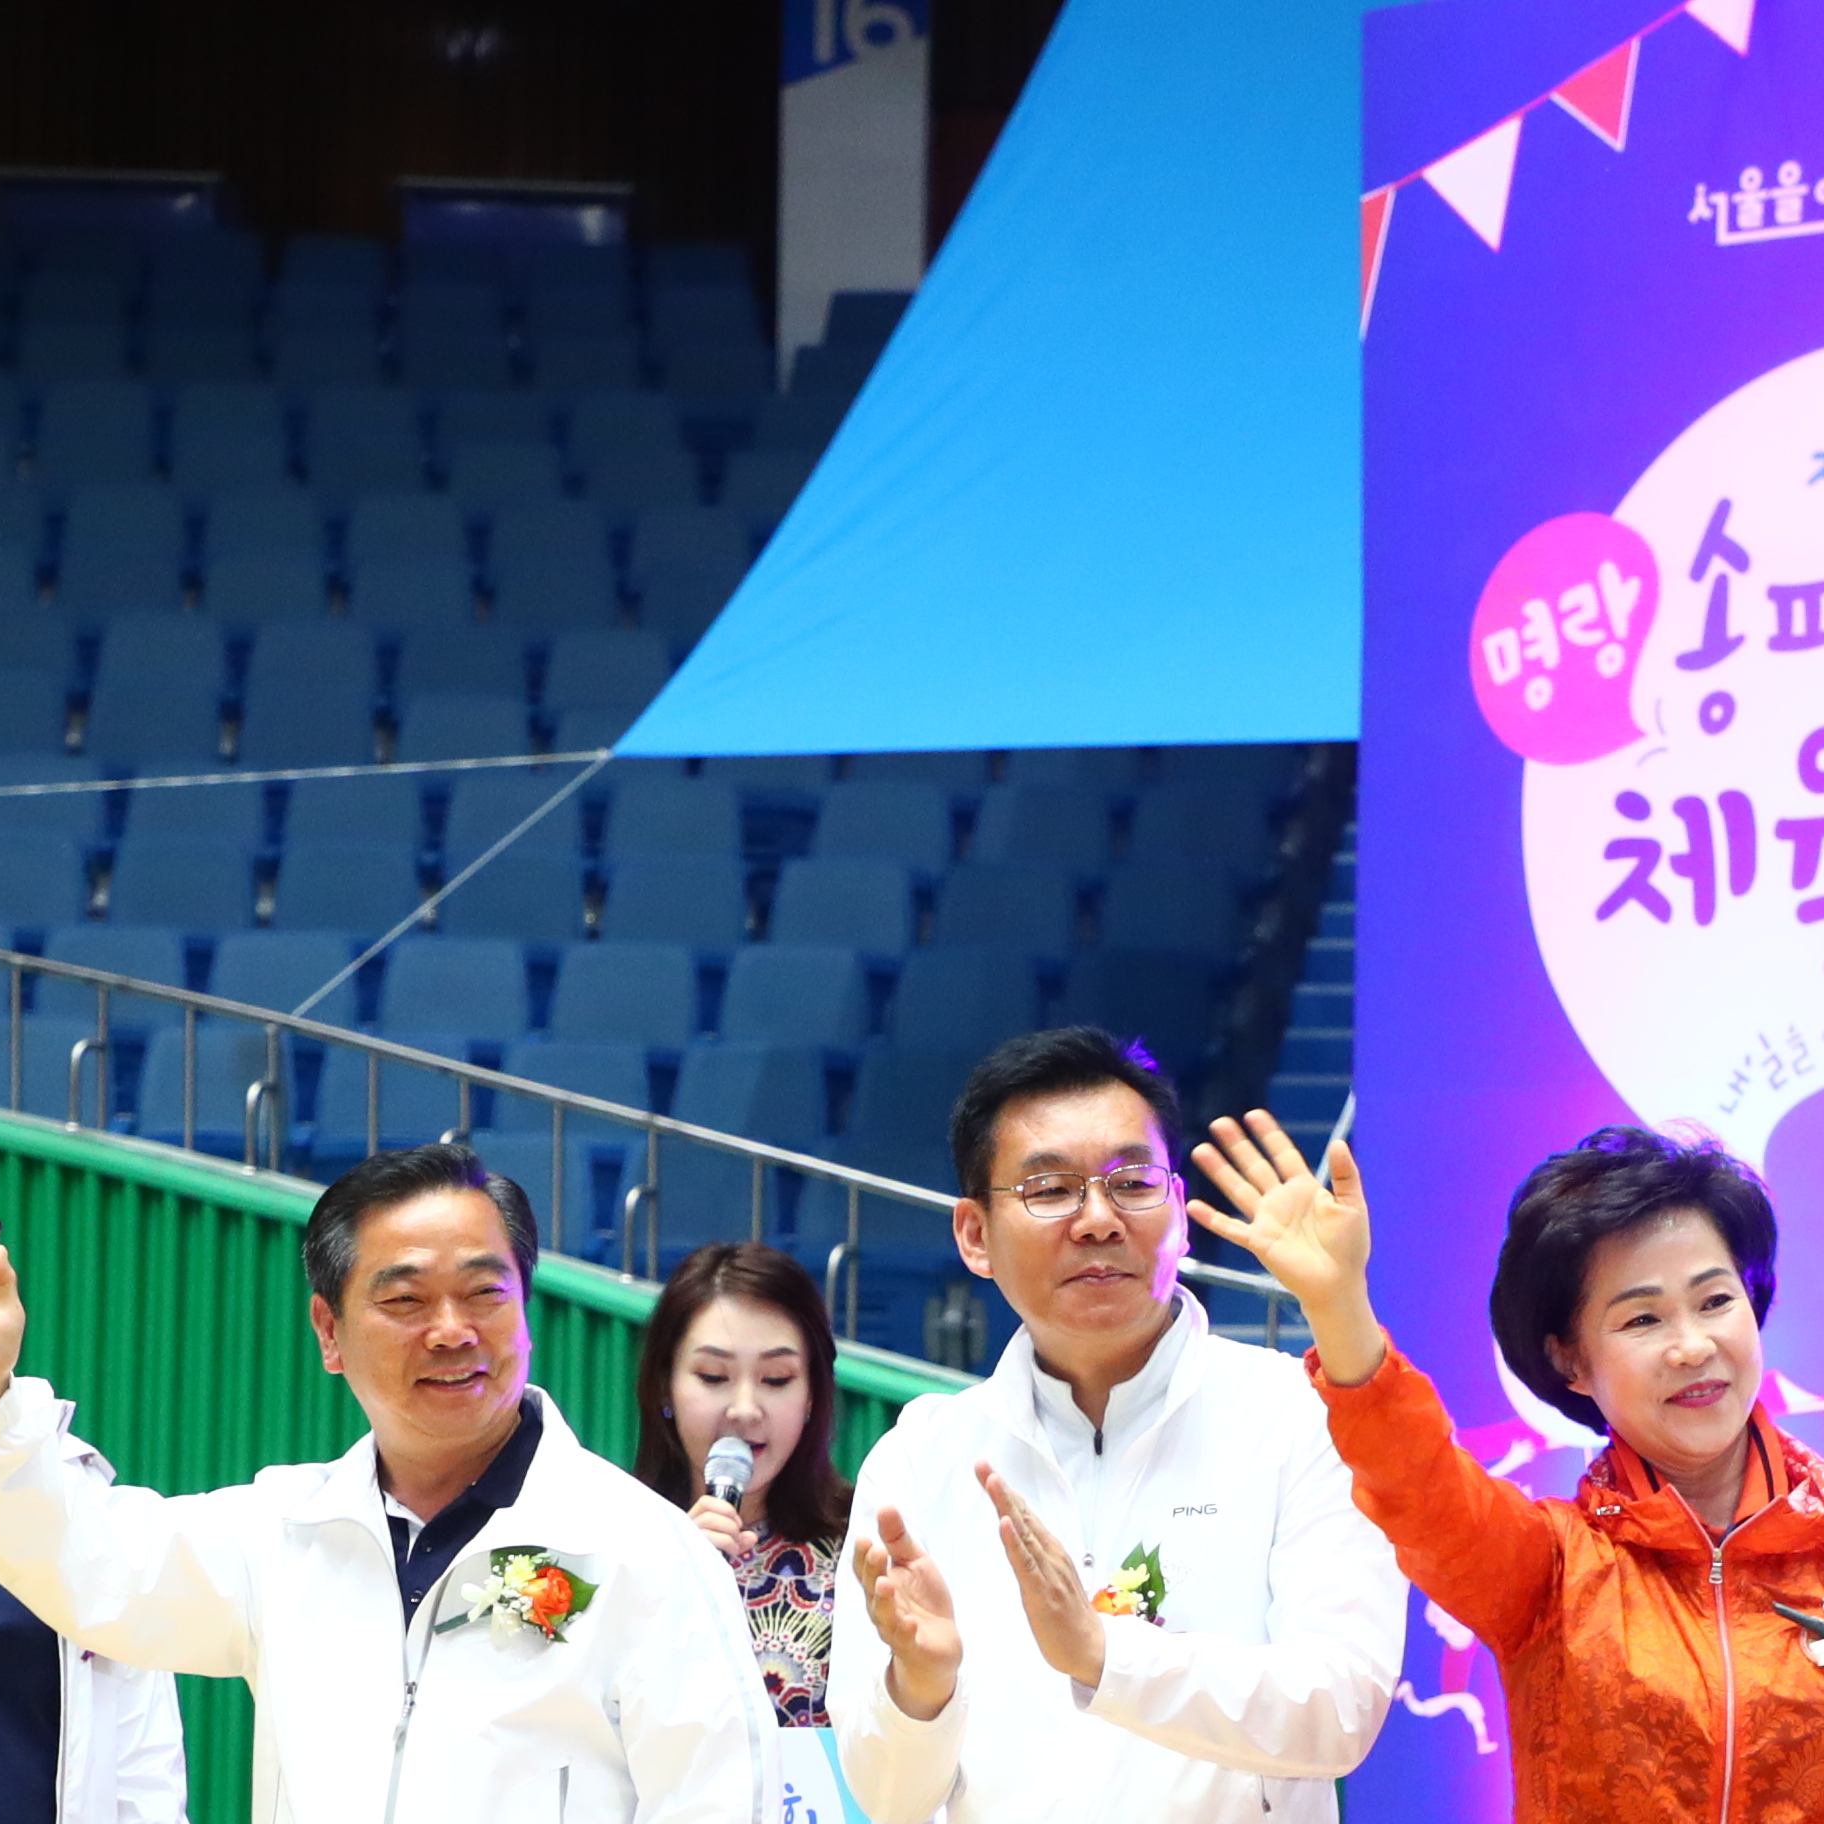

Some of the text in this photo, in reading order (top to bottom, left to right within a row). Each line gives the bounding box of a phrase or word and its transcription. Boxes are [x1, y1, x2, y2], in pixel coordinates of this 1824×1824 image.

[814, 0, 914, 62] 16
[1687, 160, 1809, 234] 서울을
[1481, 559, 1642, 712] 명랑
[1172, 1503, 1218, 1518] PING
